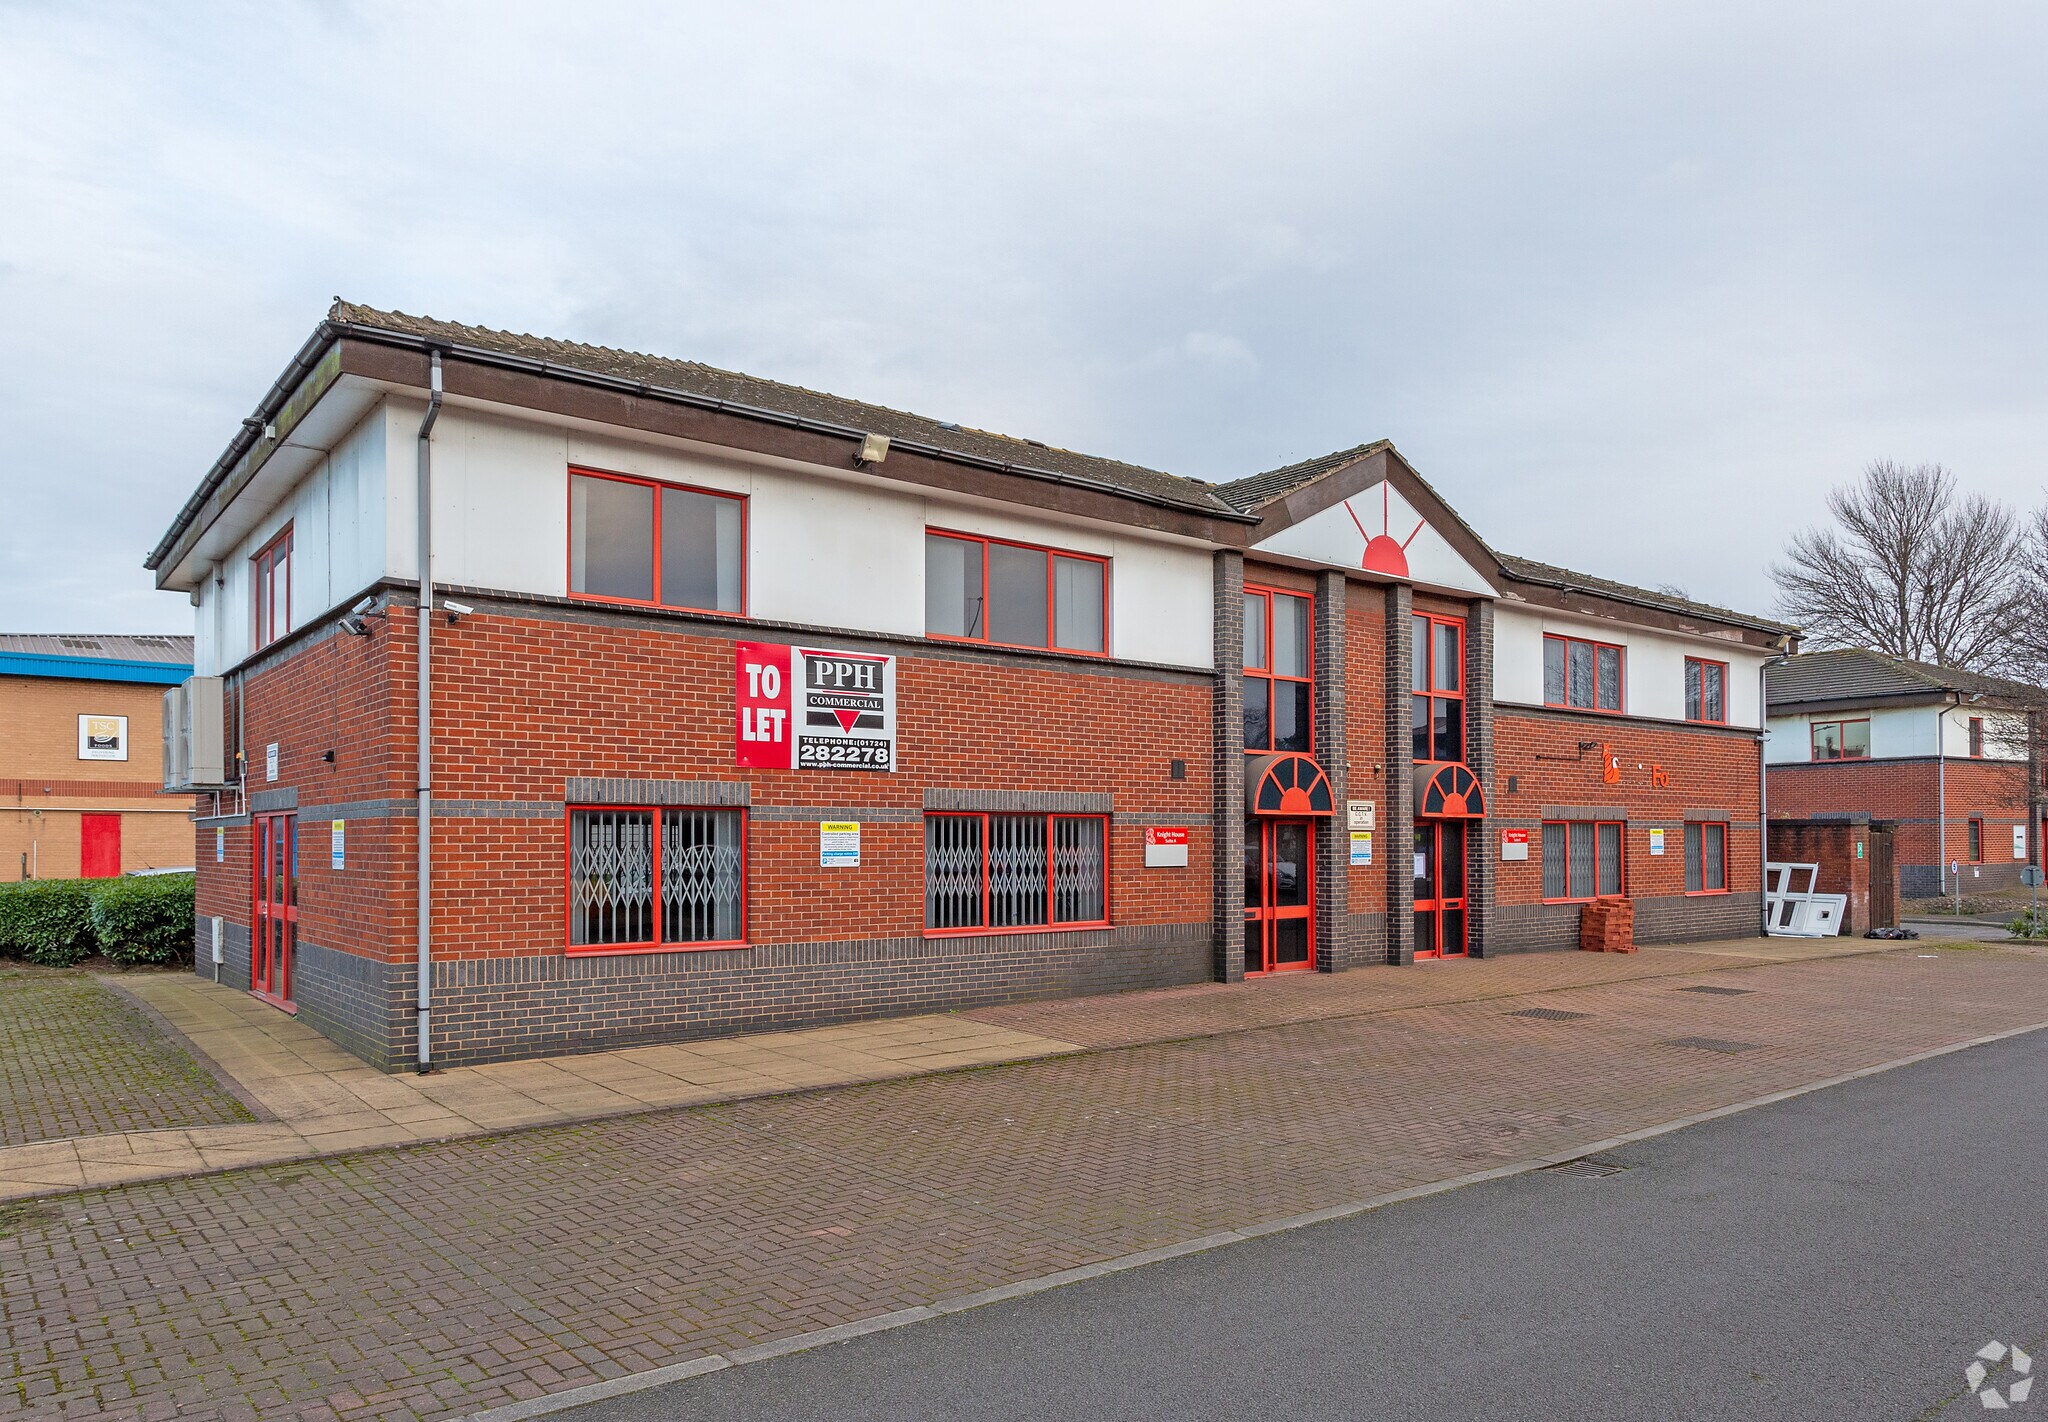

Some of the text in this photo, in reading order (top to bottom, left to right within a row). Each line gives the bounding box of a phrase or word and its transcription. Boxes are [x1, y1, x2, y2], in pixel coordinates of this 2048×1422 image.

[745, 663, 781, 700] TO
[814, 660, 876, 690] PPH
[809, 695, 881, 709] COMMERCIAL
[92, 721, 115, 730] TSC
[742, 707, 786, 743] LET
[800, 745, 889, 763] 282278
[800, 761, 889, 770] www.pph-commercial.co.uk
